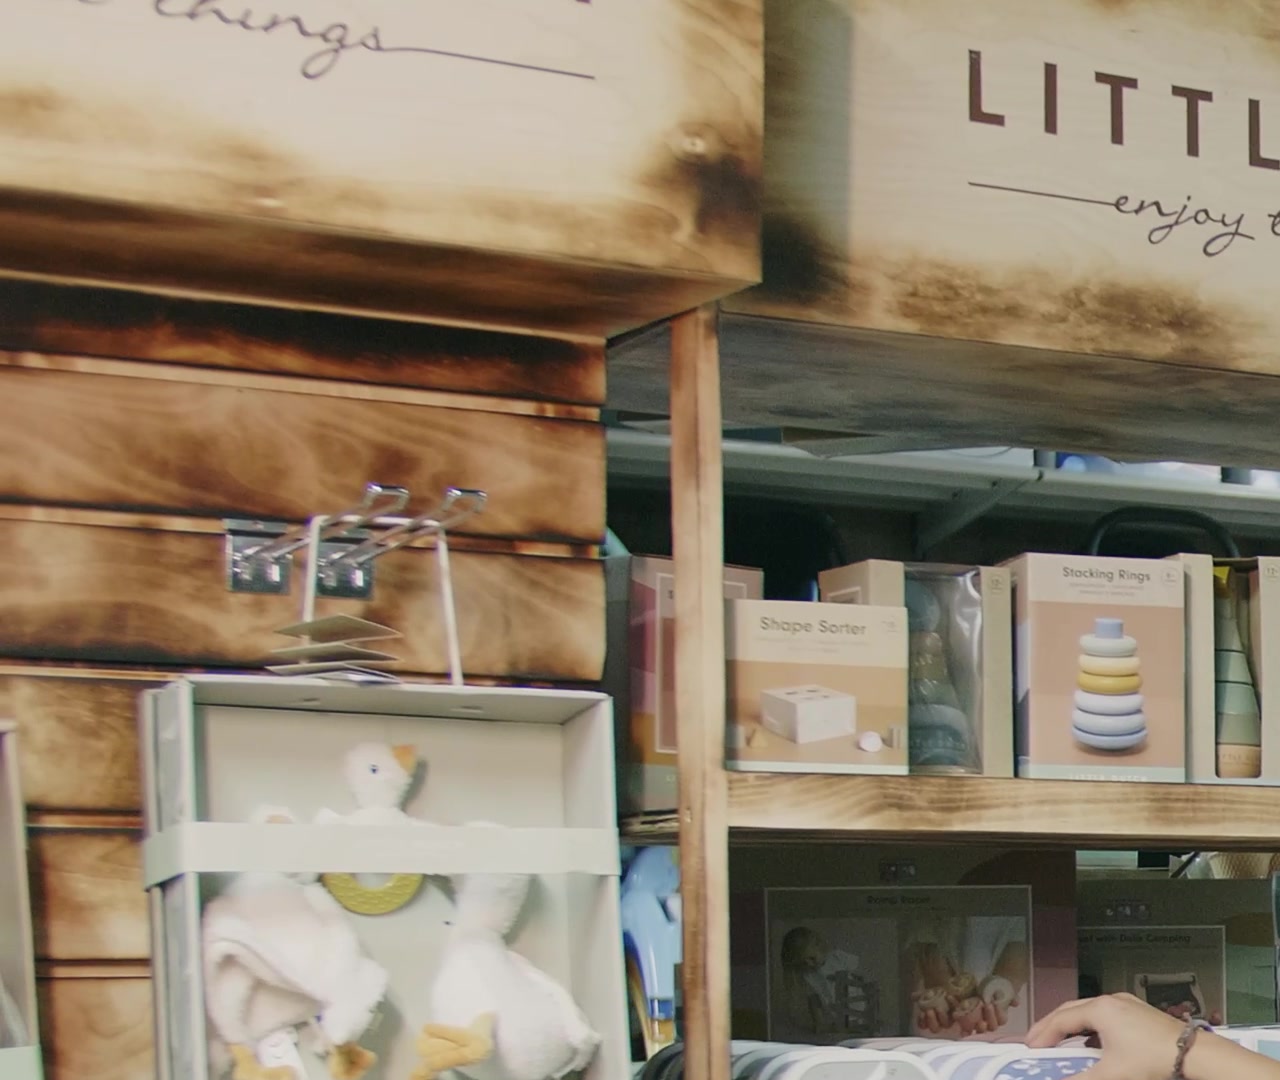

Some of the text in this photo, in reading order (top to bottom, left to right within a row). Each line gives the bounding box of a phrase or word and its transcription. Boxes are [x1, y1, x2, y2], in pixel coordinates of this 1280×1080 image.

[1112, 193, 1256, 257] enjoy
[1062, 566, 1114, 582] Stacking
[1119, 569, 1151, 584] Rings
[760, 616, 867, 636] Shape Sorter
